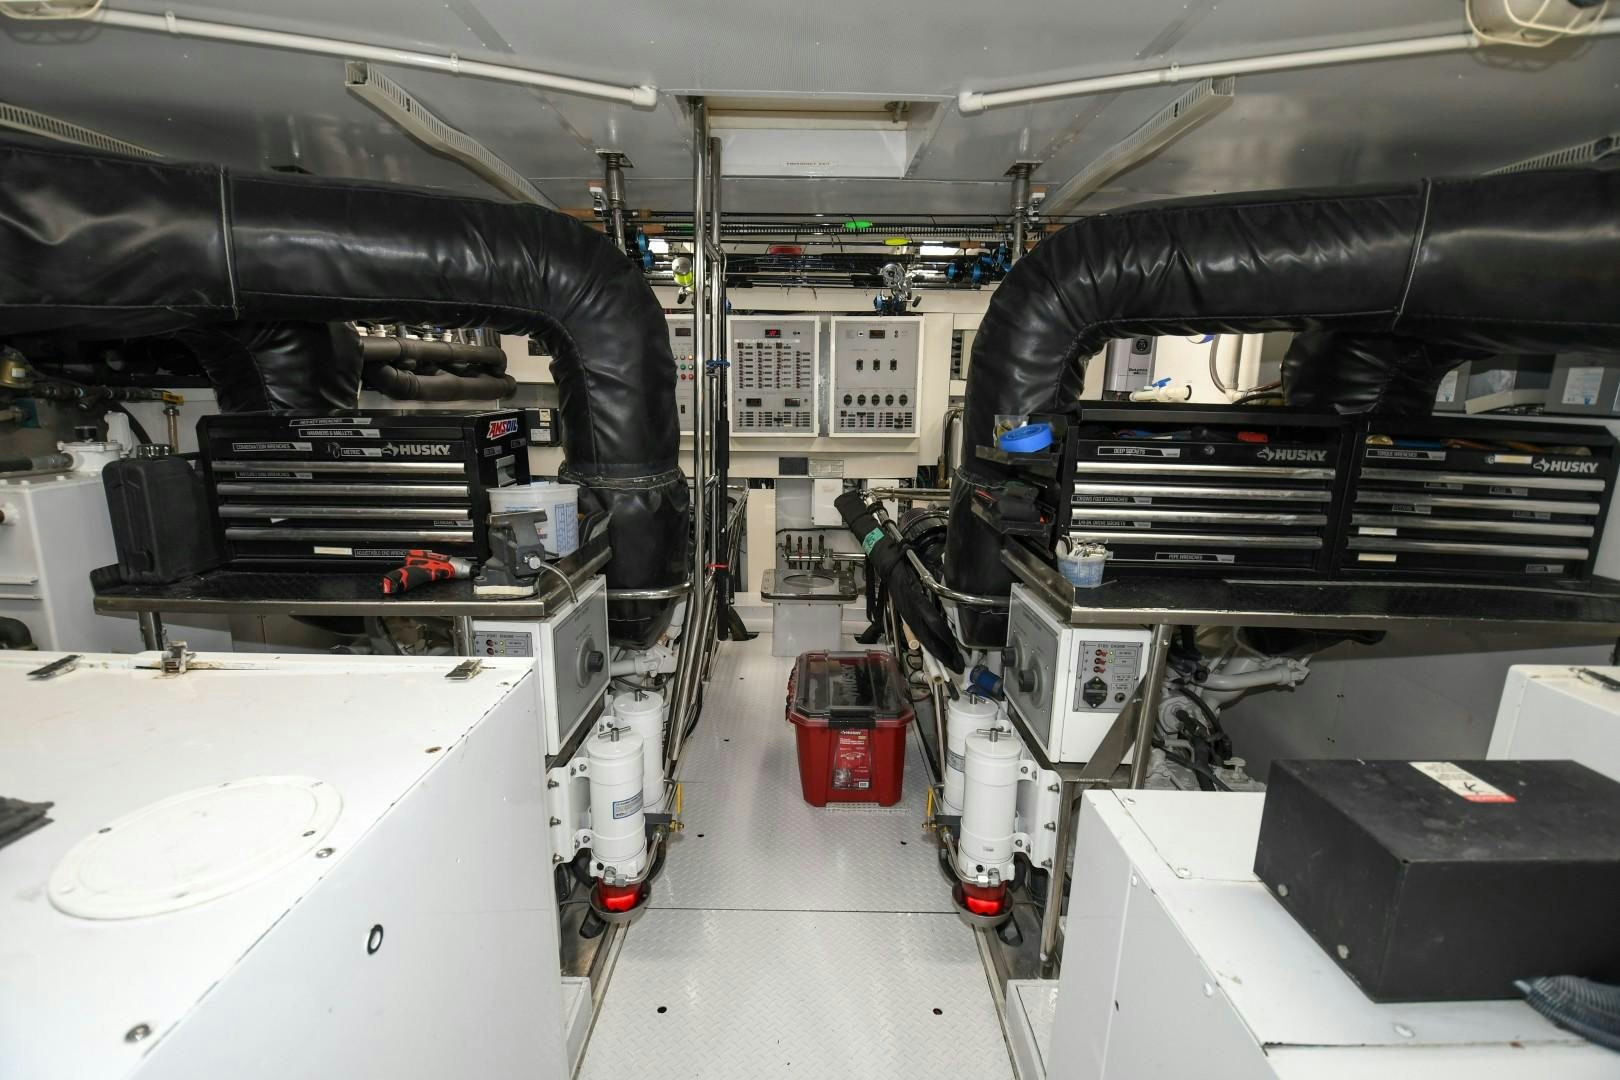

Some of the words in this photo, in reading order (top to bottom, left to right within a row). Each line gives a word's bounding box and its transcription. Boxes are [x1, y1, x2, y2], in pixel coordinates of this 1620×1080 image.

[488, 419, 518, 439] AMSOIL
[399, 444, 451, 456] HUSKY
[1275, 449, 1328, 462] HUSKY
[1550, 460, 1599, 473] HUSKY
